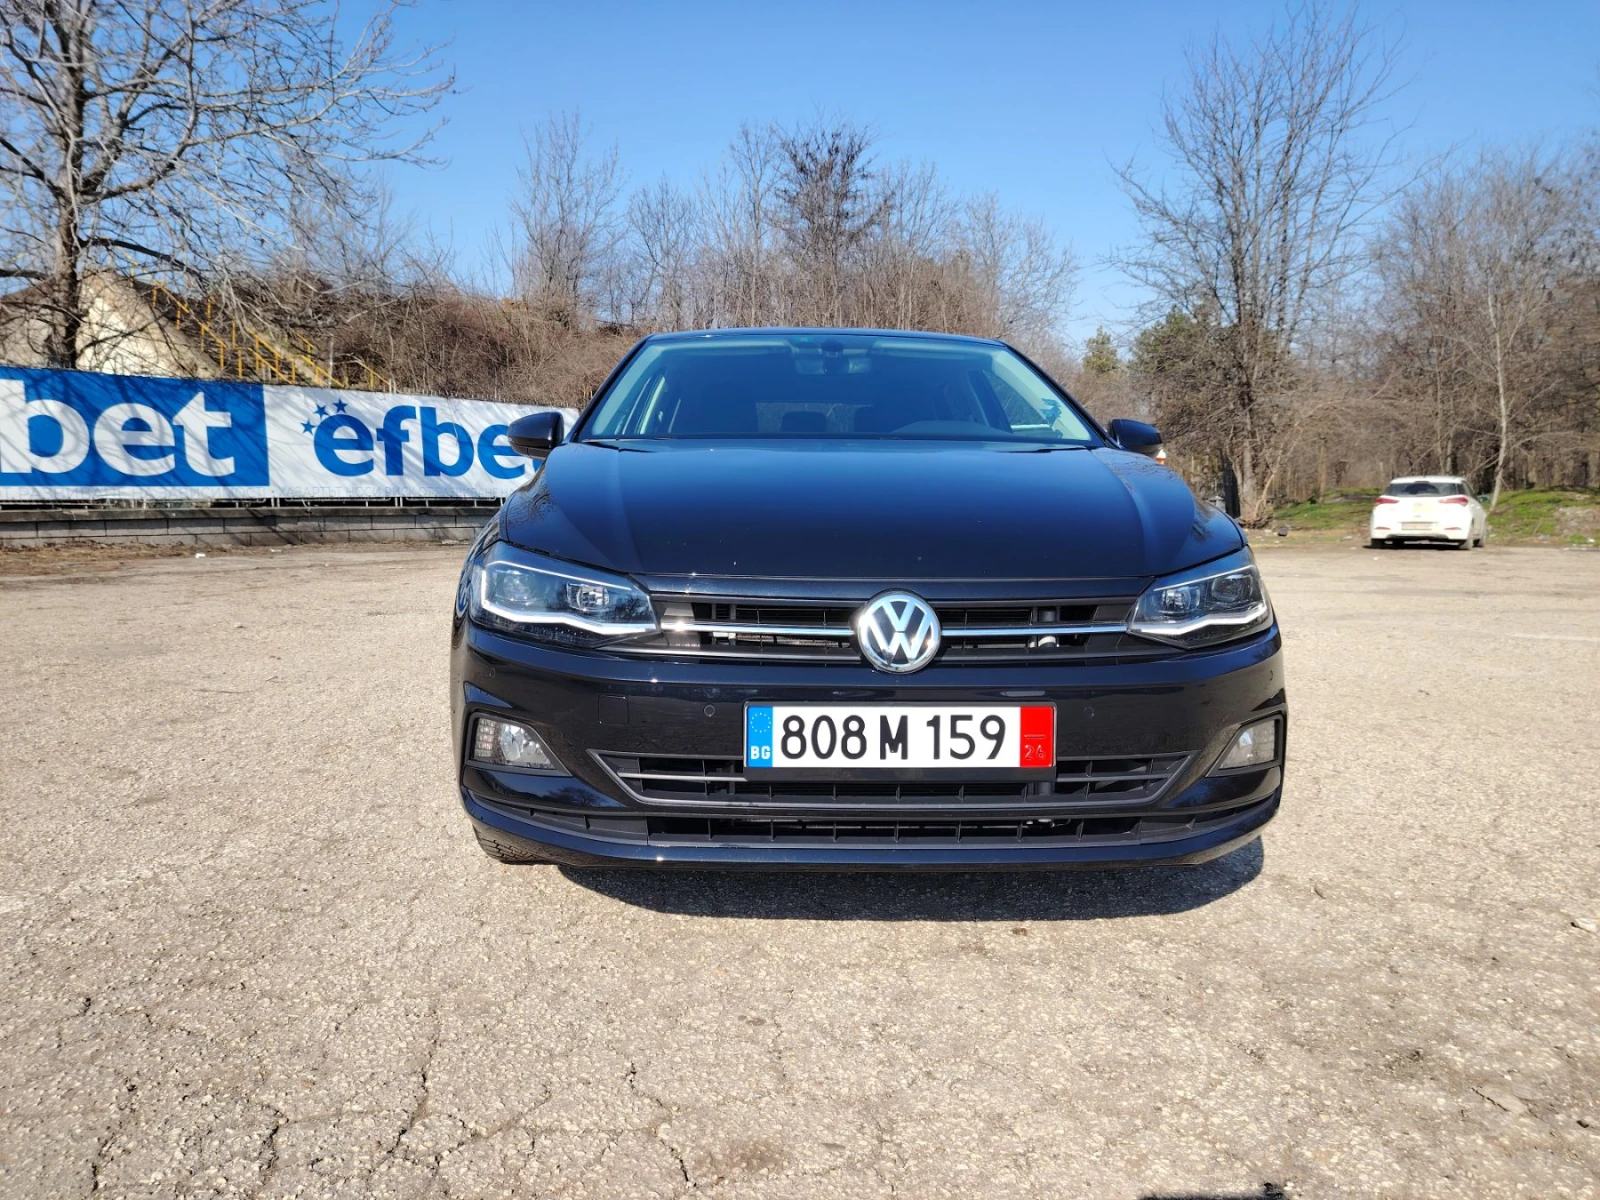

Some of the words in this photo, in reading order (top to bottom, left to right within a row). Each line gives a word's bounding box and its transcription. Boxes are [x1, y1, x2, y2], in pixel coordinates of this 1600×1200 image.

[0, 379, 236, 477] bet
[313, 404, 542, 480] efbe
[750, 745, 771, 760] BG
[780, 714, 867, 760] 808
[879, 714, 909, 760] M
[926, 714, 1006, 760] 159
